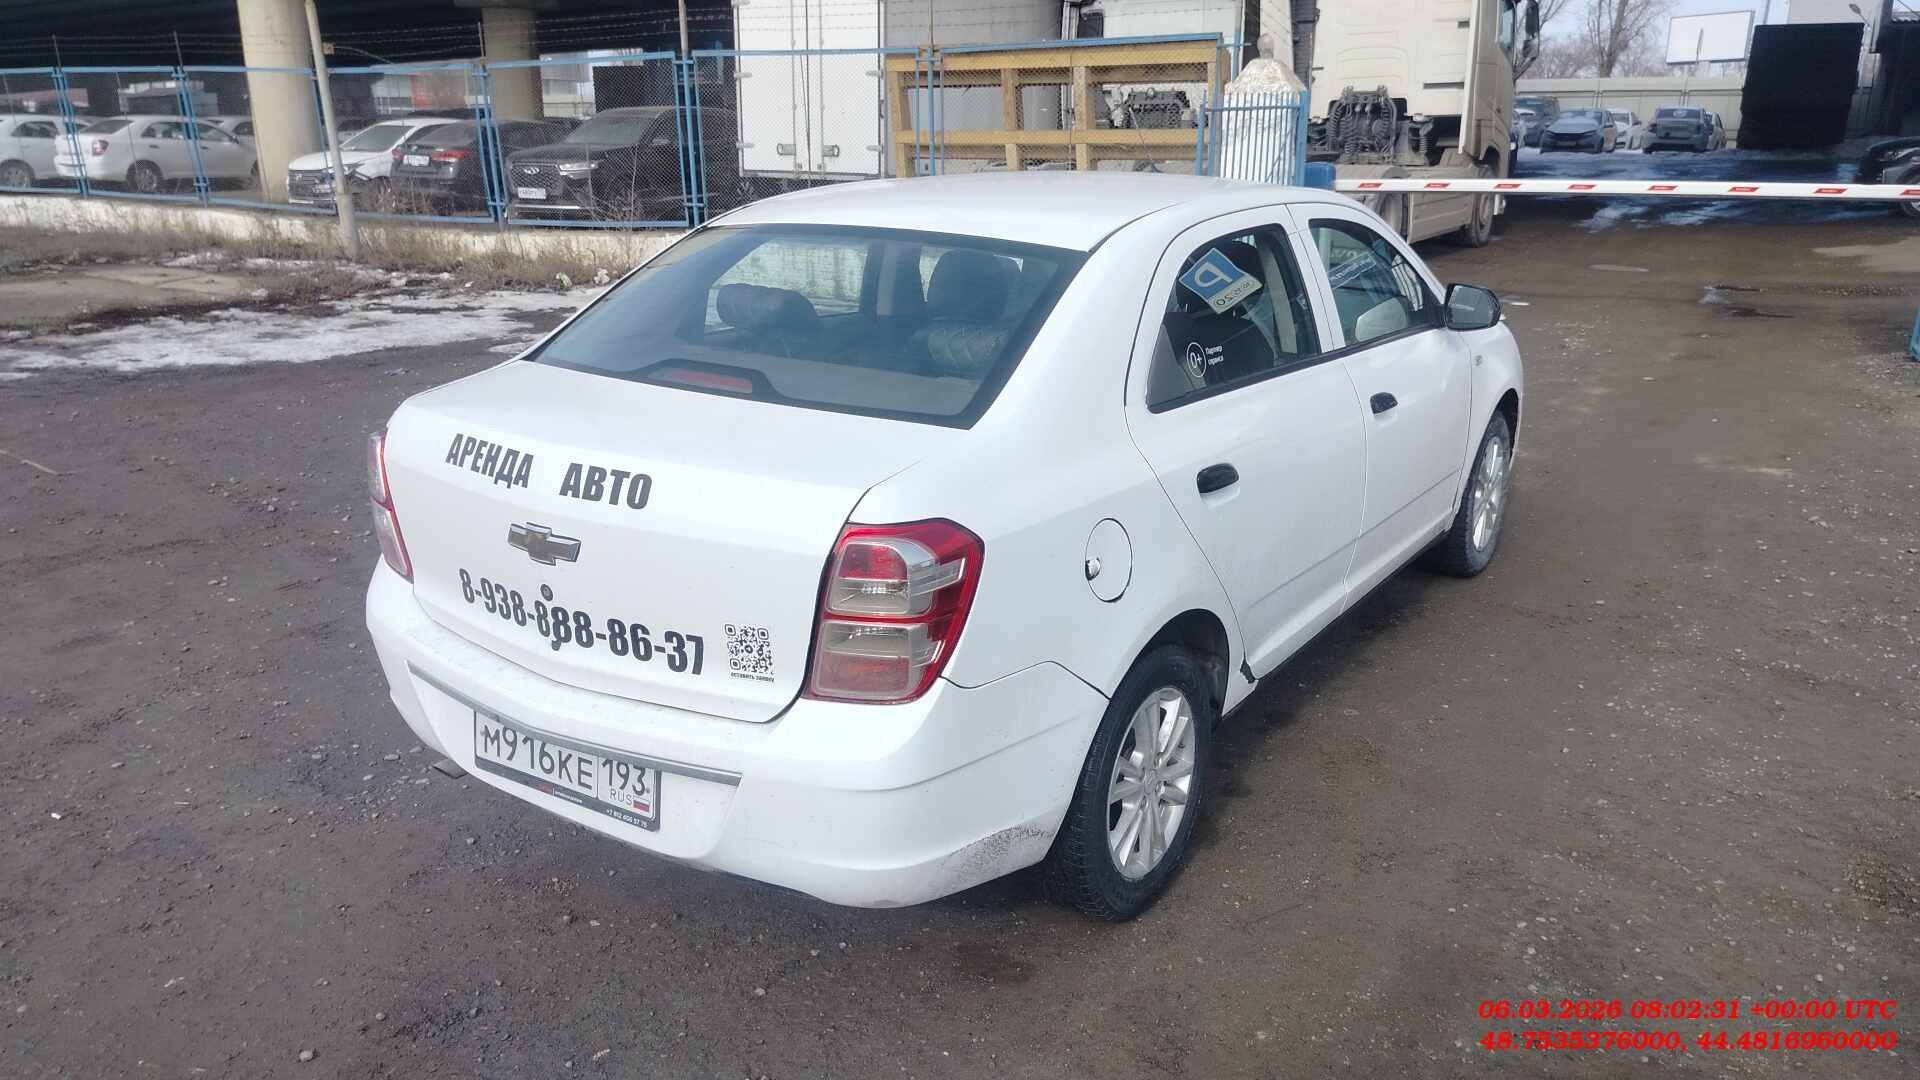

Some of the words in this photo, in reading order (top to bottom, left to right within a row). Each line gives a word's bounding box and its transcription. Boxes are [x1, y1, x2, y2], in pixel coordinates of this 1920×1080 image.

[445, 433, 534, 489] АРЕНДА
[559, 462, 653, 510] АВТО
[459, 568, 704, 675] 8-938-888-86-37
[602, 759, 646, 796] 193
[611, 789, 633, 805] RUS
